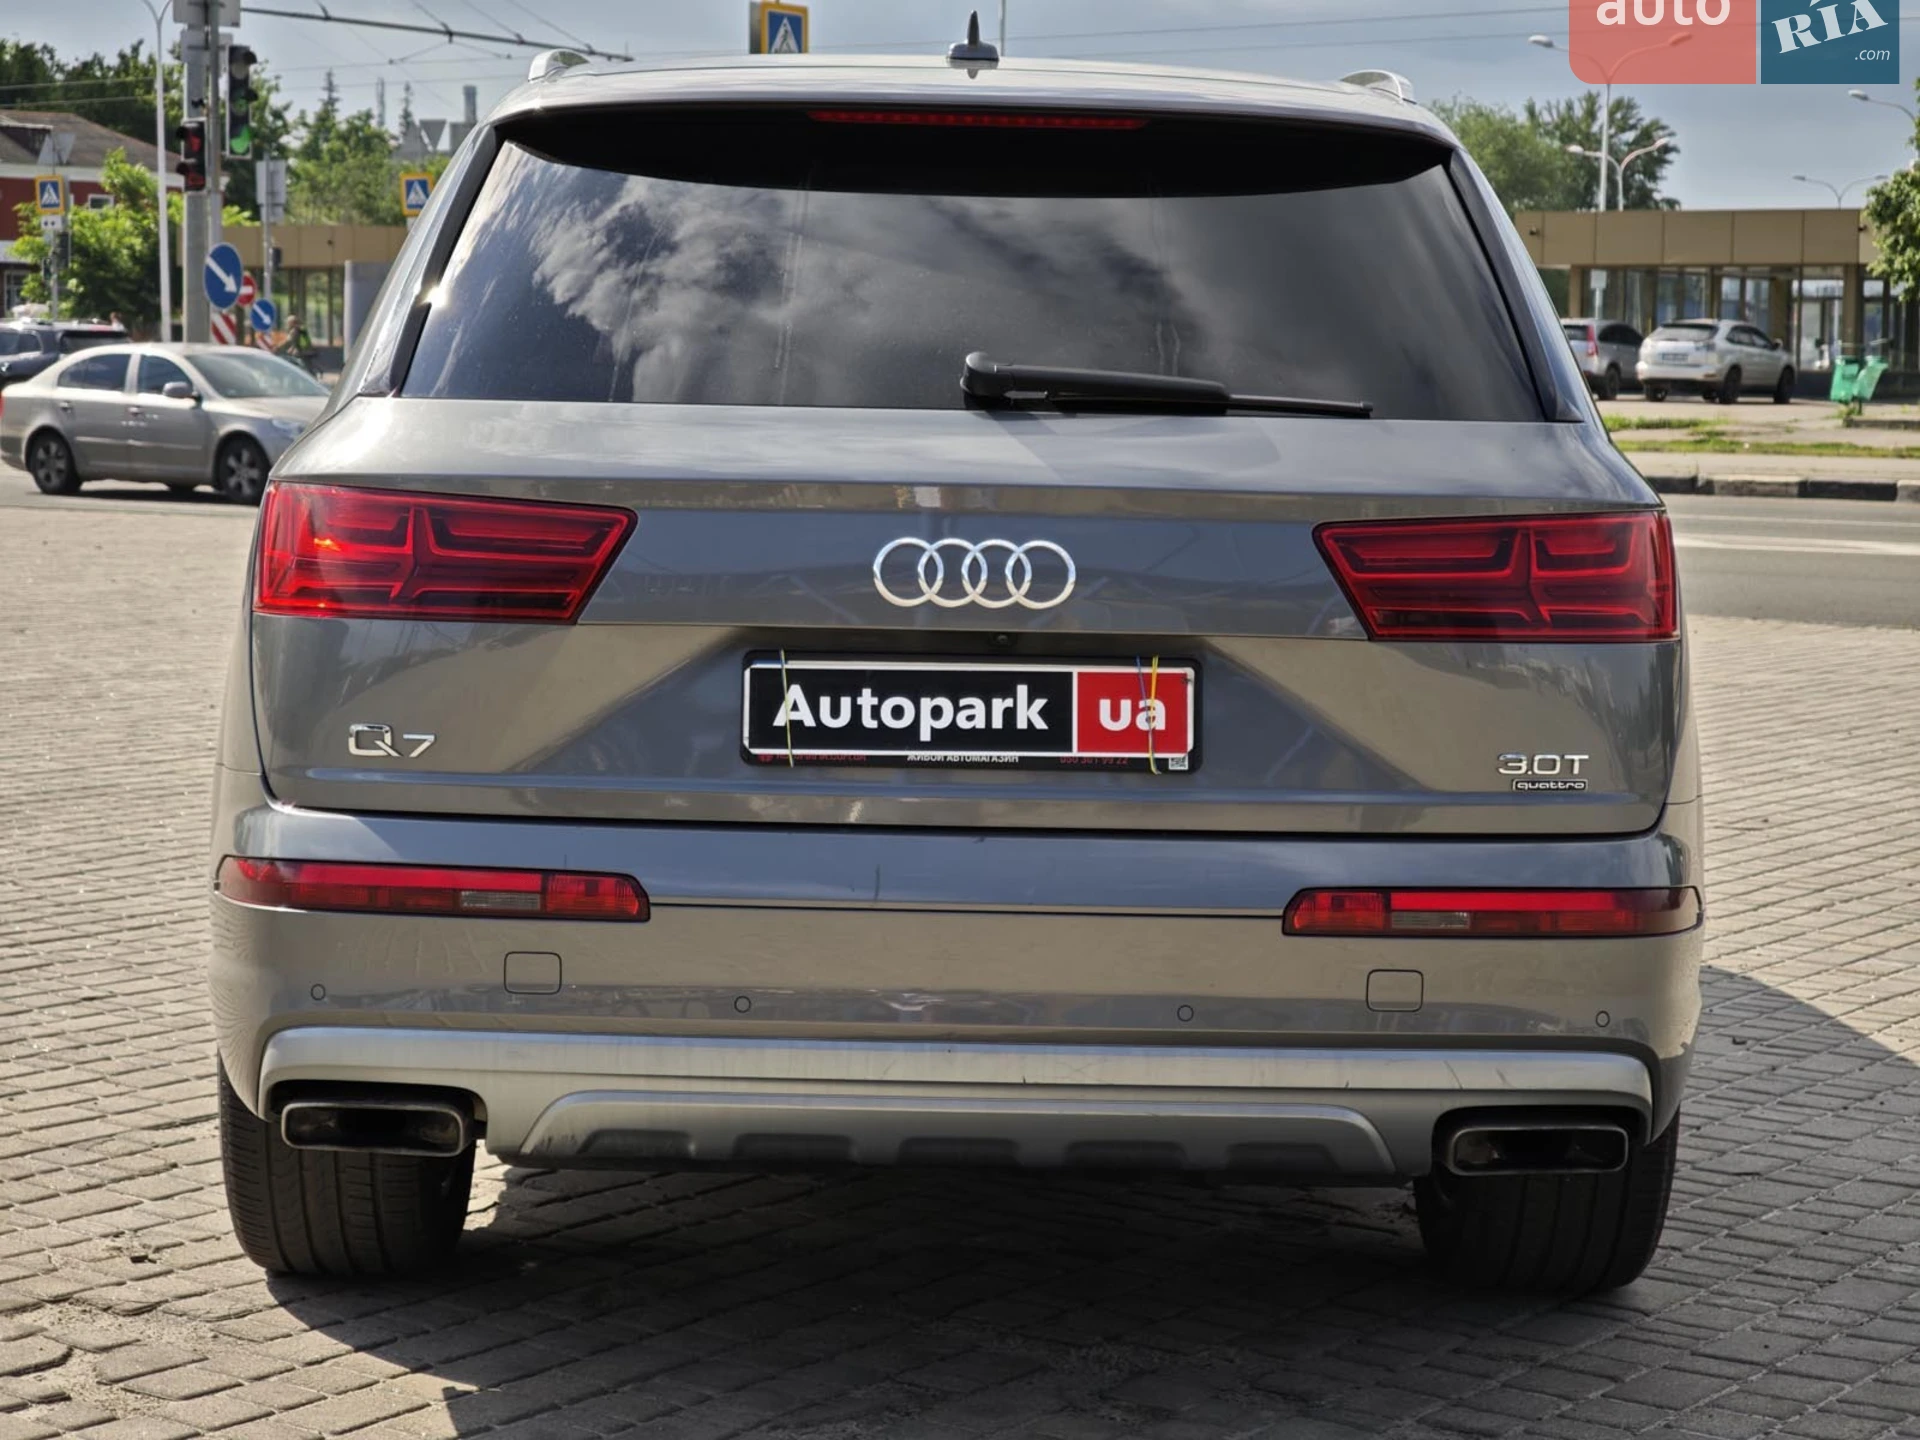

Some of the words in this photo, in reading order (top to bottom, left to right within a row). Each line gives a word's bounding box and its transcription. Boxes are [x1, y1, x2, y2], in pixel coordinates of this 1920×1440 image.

[772, 684, 1049, 742] Autopark
[1097, 698, 1167, 731] ua
[348, 723, 436, 758] Q7
[1498, 754, 1590, 775] 3.0T
[1517, 780, 1585, 791] quattro
